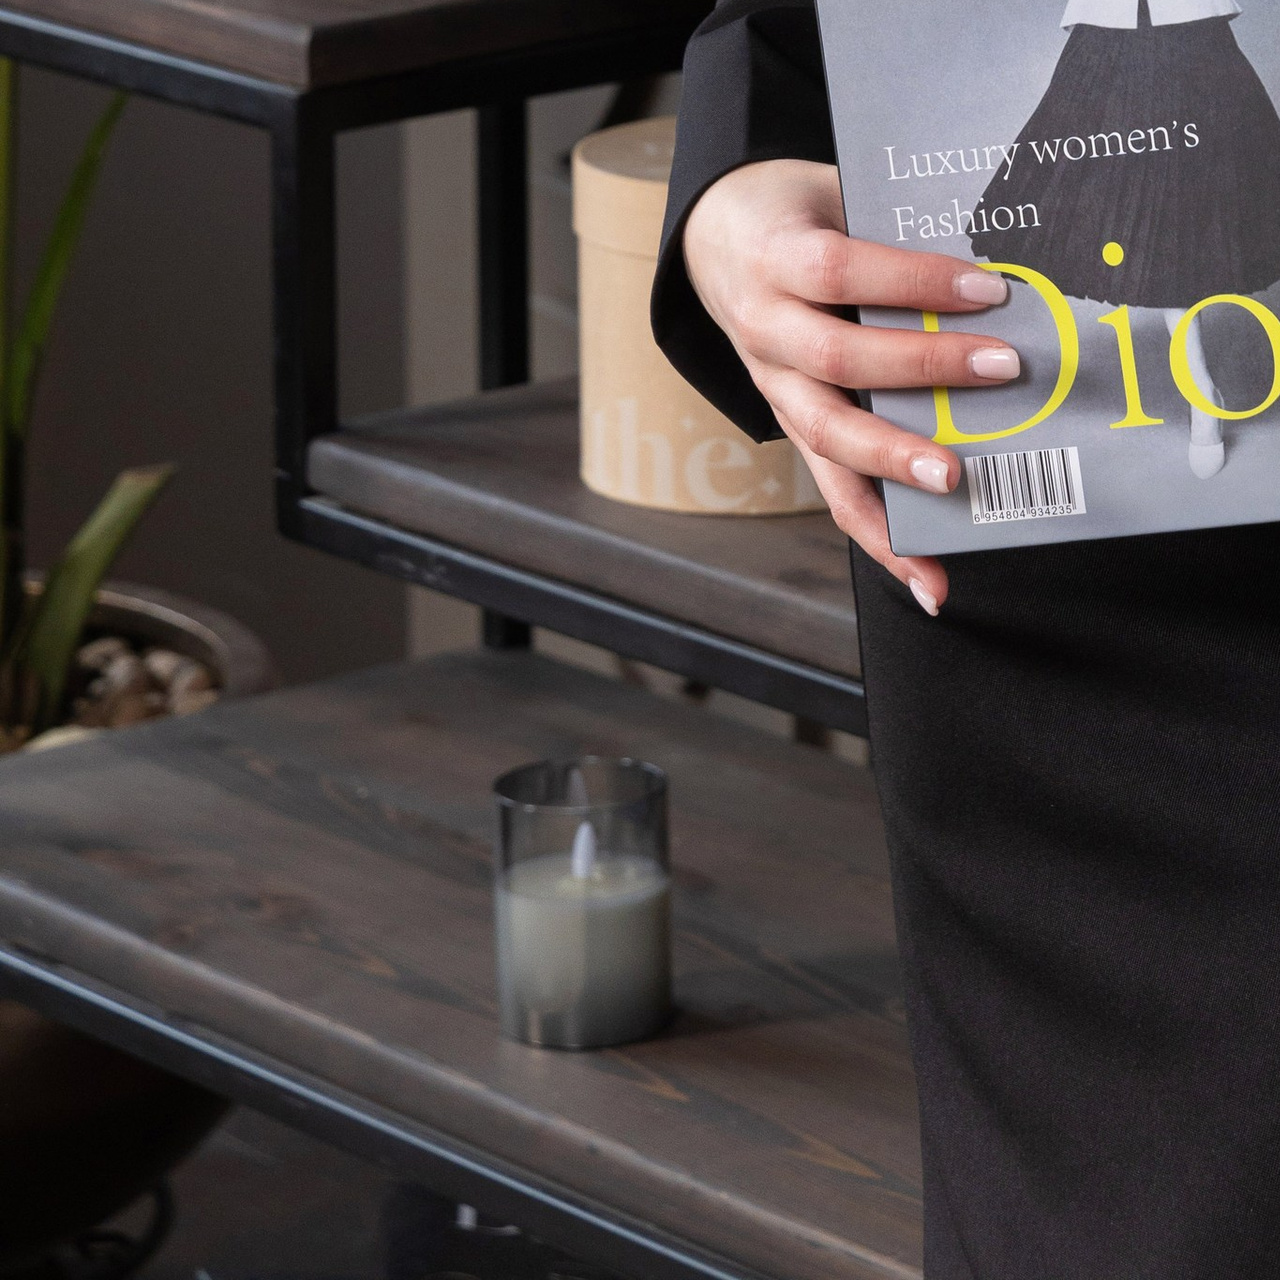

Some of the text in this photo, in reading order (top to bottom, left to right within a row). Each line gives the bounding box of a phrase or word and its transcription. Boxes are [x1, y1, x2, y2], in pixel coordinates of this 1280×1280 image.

[883, 120, 1200, 181] Luxury women's
[892, 197, 1042, 242] Fashion
